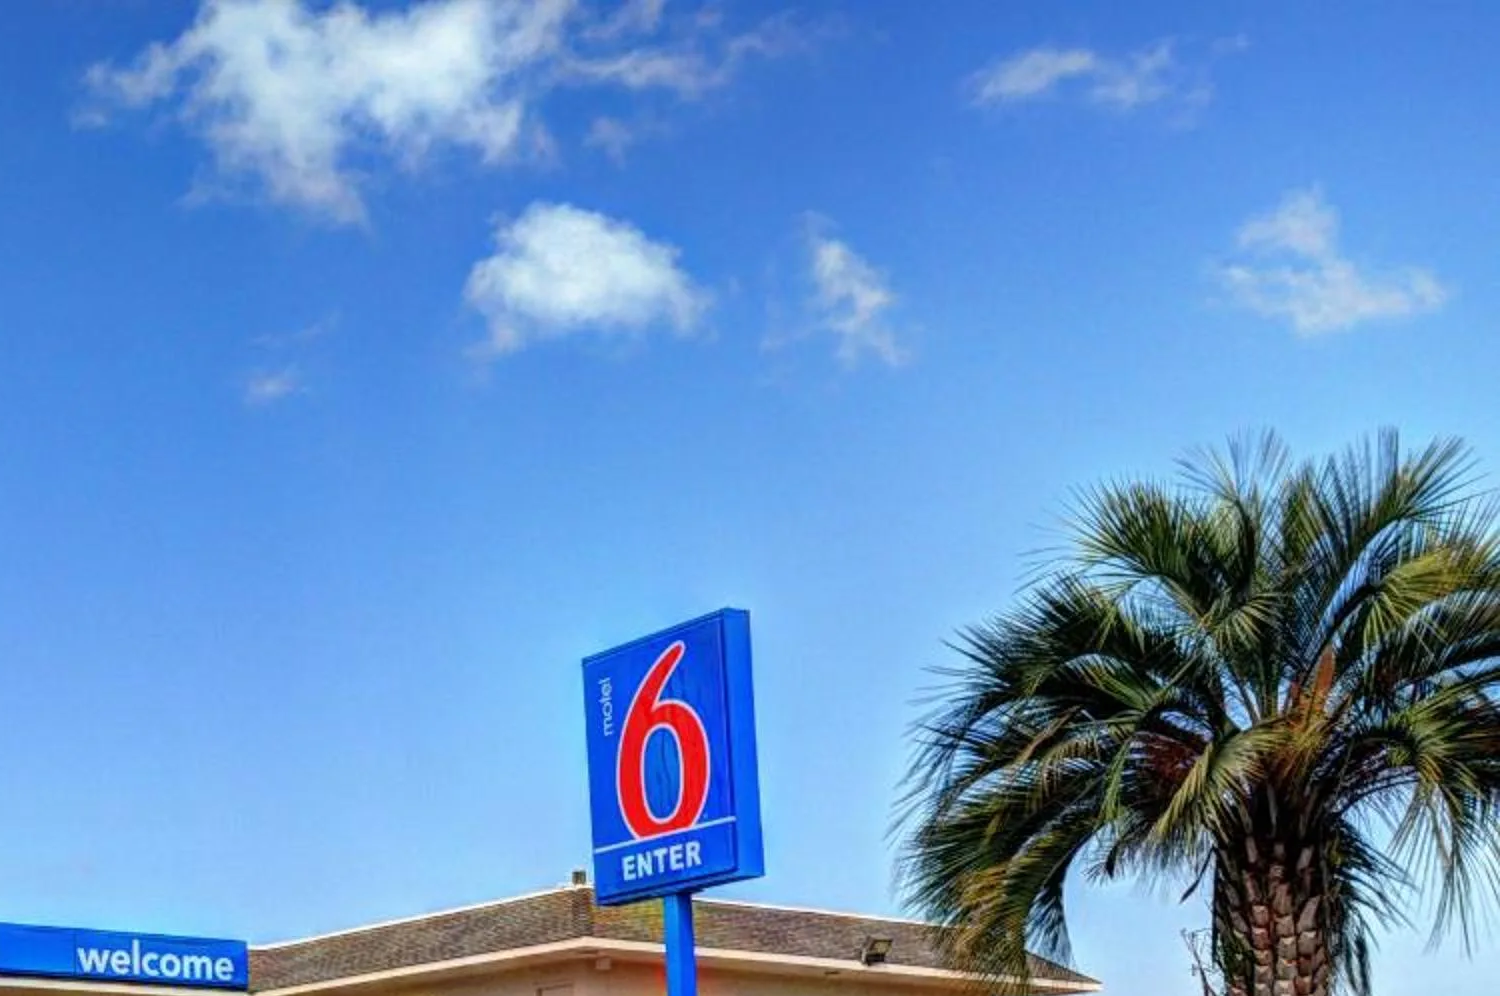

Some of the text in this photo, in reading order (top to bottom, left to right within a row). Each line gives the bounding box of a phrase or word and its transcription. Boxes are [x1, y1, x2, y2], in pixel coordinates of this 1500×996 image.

[598, 677, 613, 737] motel
[616, 640, 711, 840] 6
[621, 841, 703, 881] ENTER
[77, 938, 236, 981] welcome
